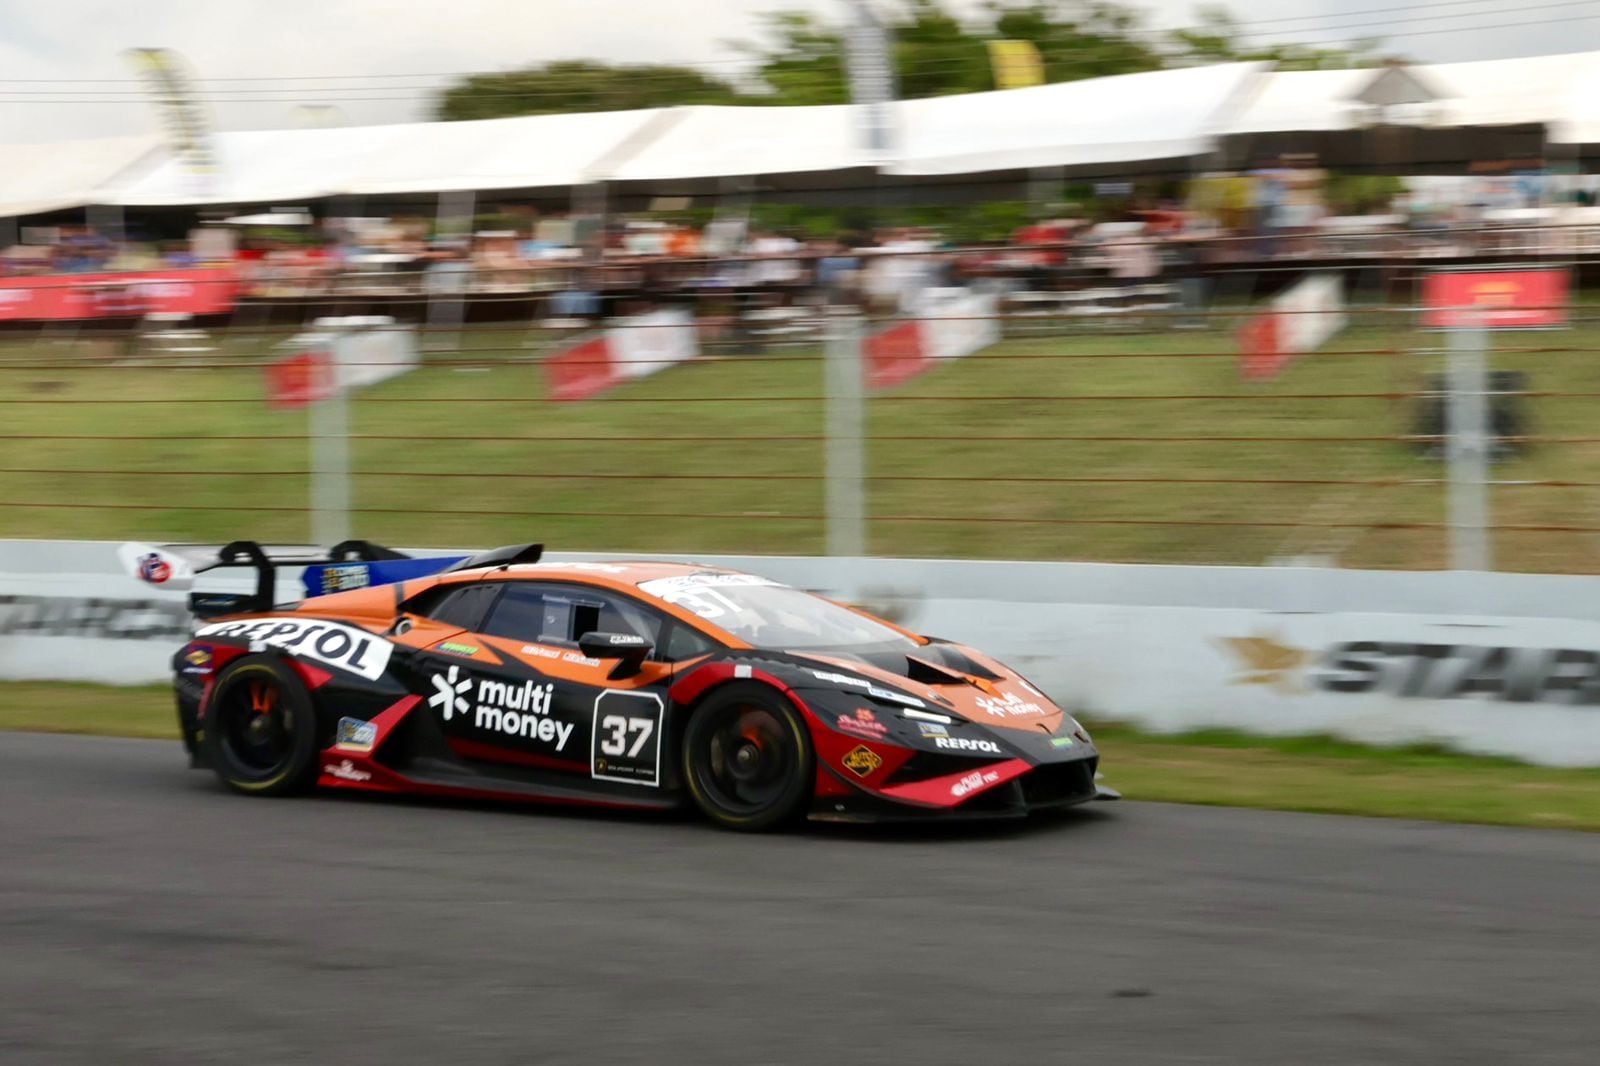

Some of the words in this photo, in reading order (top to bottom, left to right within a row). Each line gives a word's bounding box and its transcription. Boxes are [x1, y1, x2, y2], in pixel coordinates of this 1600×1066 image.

[211, 622, 371, 671] REPSOL
[1310, 640, 1600, 706] STAR
[478, 680, 555, 716] multi
[475, 705, 575, 751] money
[601, 714, 654, 758] 37
[935, 737, 1002, 754] REPSOL
